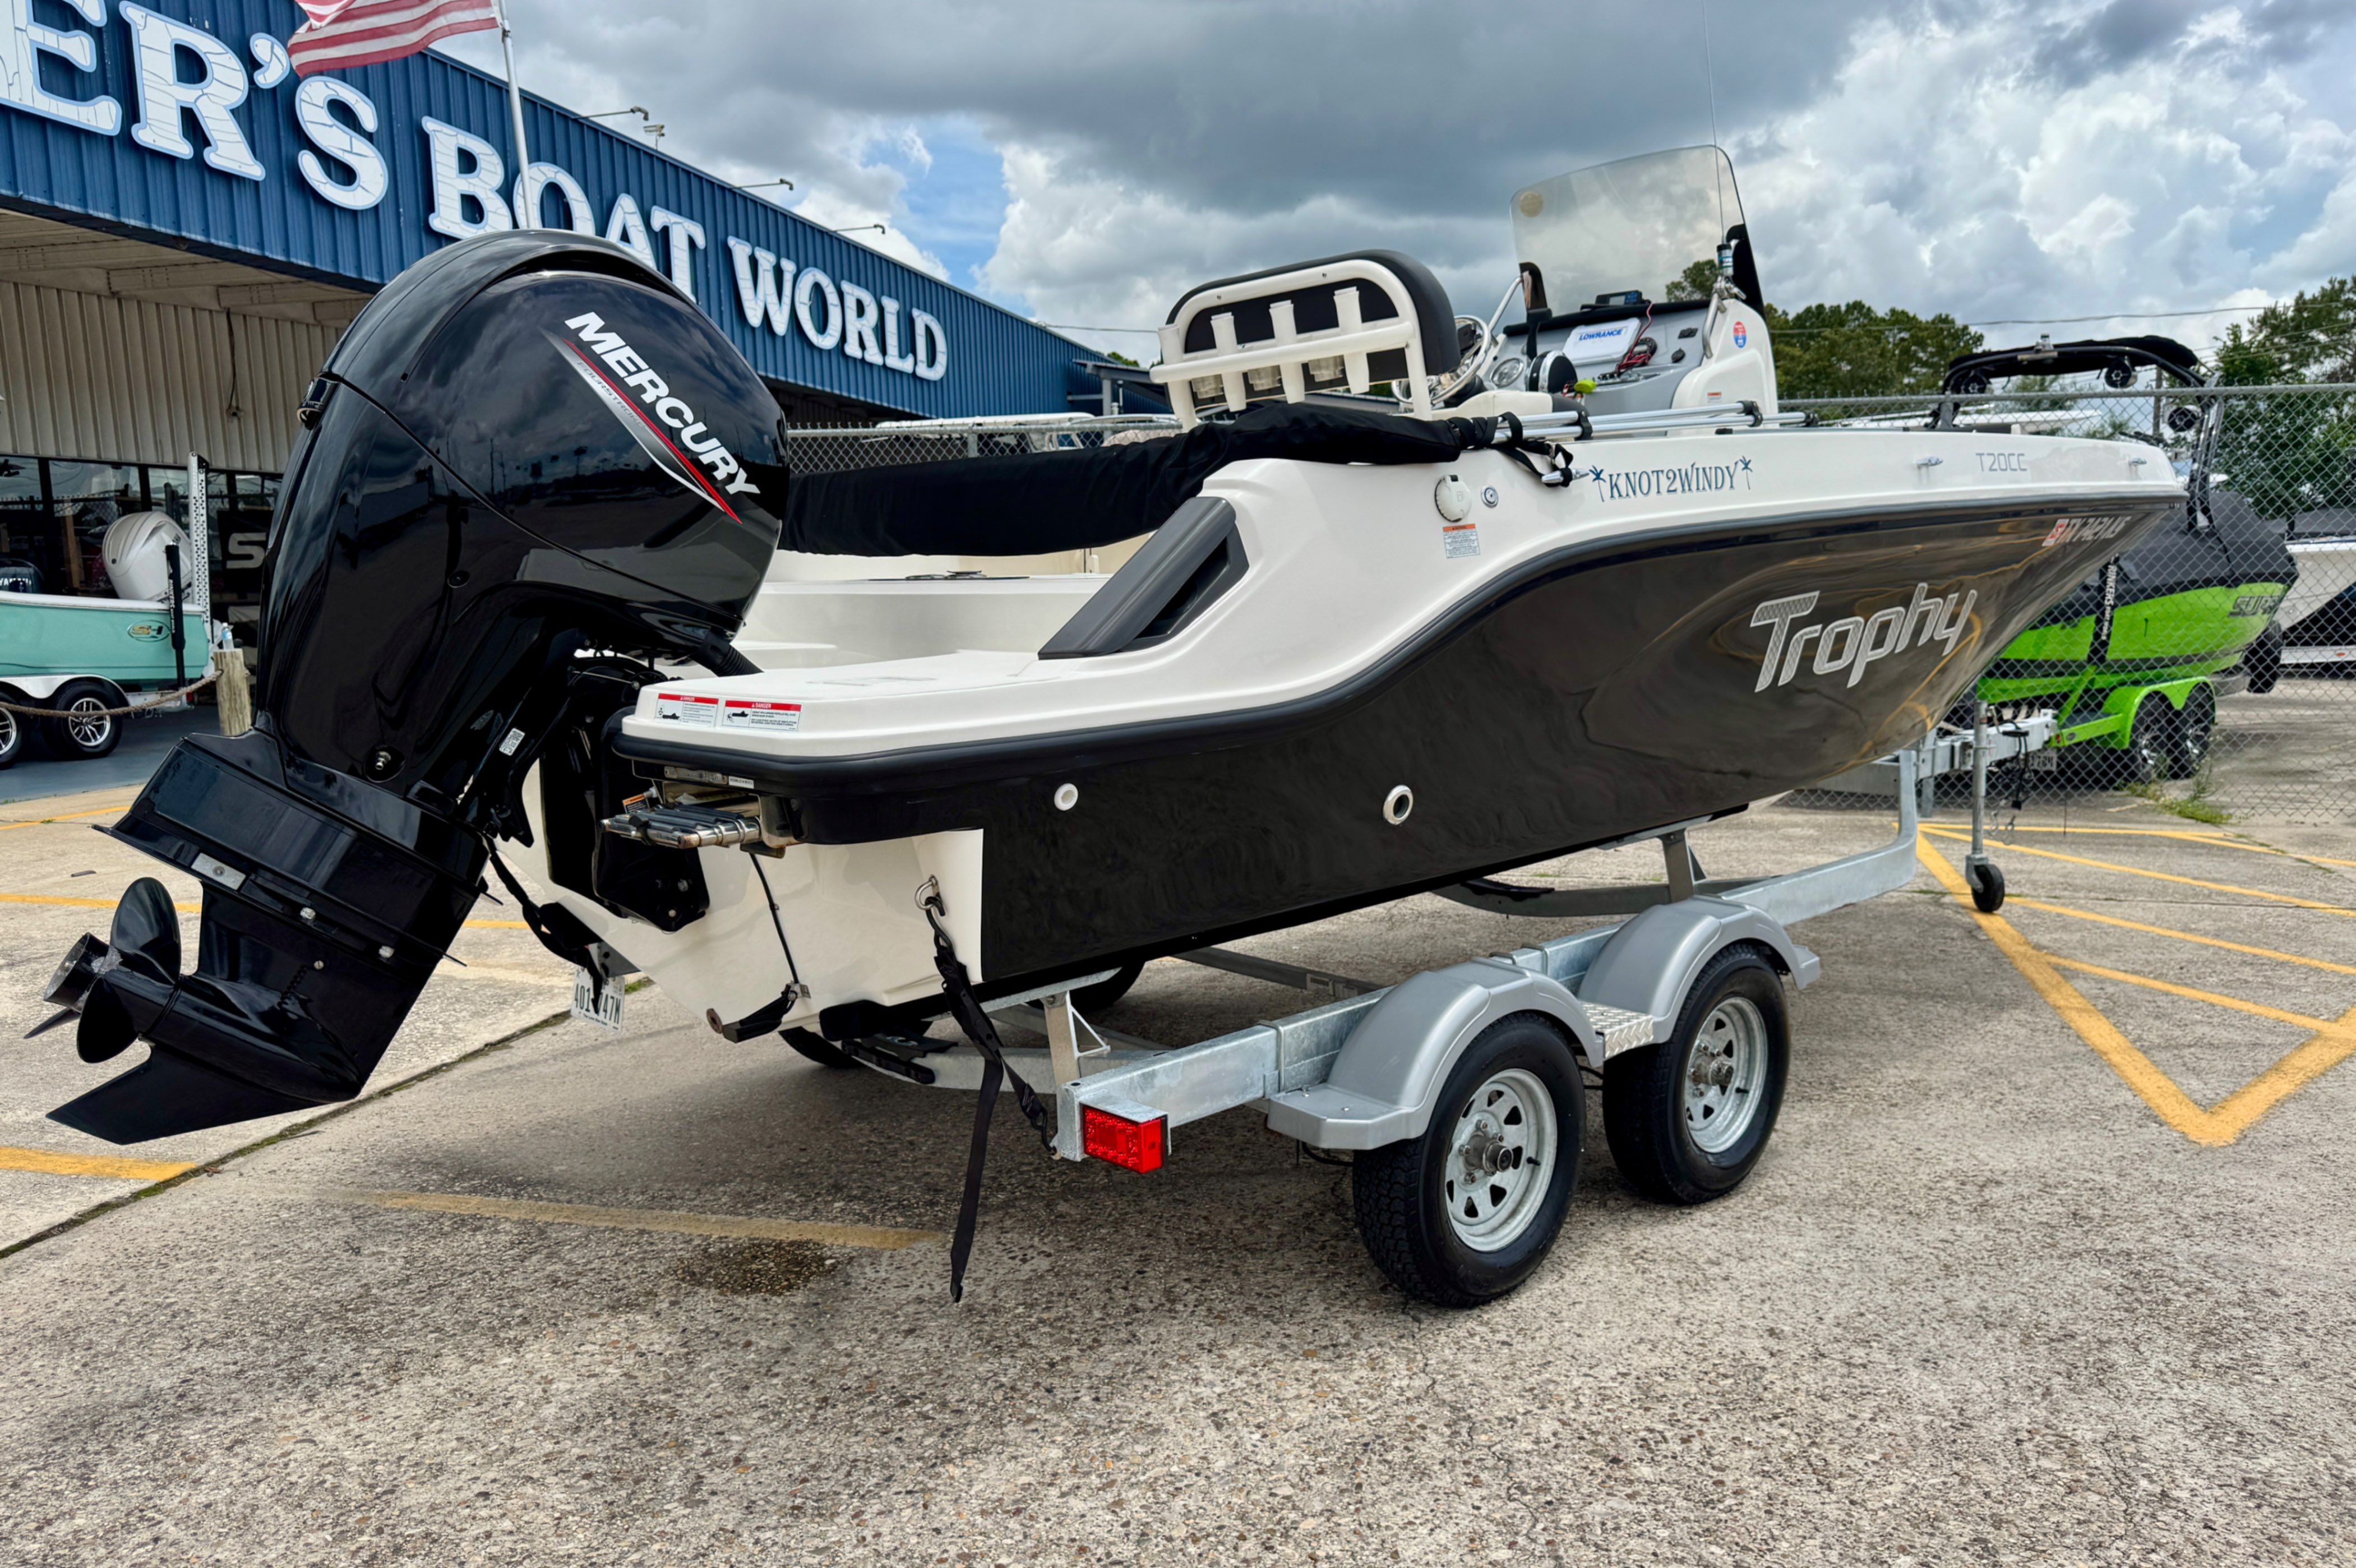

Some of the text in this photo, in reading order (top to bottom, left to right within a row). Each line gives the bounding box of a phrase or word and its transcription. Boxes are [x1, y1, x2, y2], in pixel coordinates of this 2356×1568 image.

[422, 115, 706, 304] BOAT
[727, 235, 948, 381] WORLD
[1579, 328, 1623, 341] LOWRANCE
[564, 311, 761, 494] MERCURY
[578, 362, 644, 428] FOURSTROKE
[1608, 461, 1739, 499] KNOT2WINDY
[1975, 452, 2027, 471] T20CC
[1749, 582, 1978, 693] Trophy
[575, 983, 590, 1013] 401
